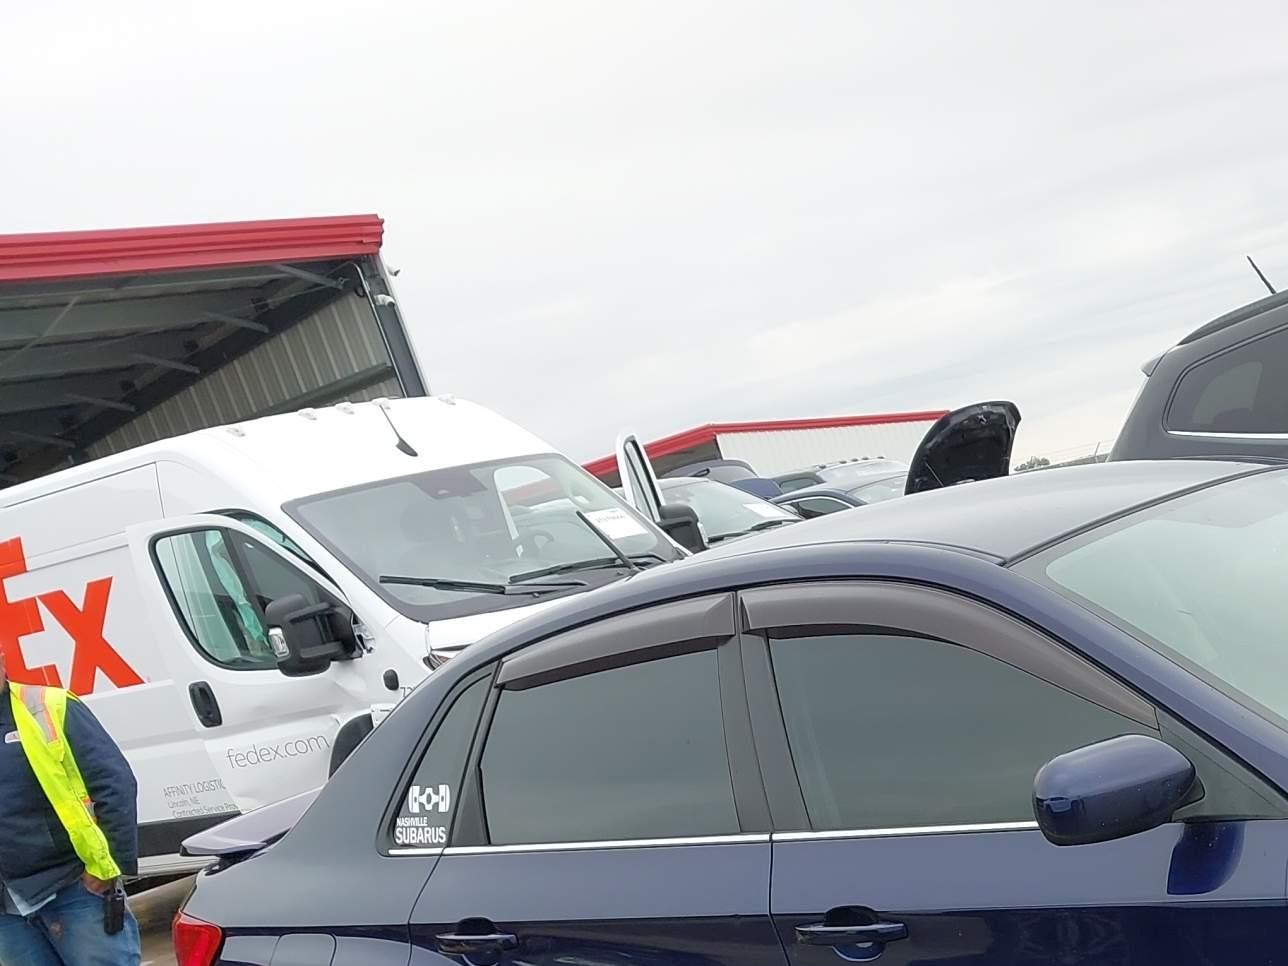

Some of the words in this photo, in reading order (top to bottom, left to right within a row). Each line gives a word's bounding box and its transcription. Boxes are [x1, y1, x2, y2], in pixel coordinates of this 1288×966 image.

[226, 735, 331, 769] fedex.com
[396, 816, 428, 827] NASHVILLE
[395, 826, 447, 844] SUBARUS
